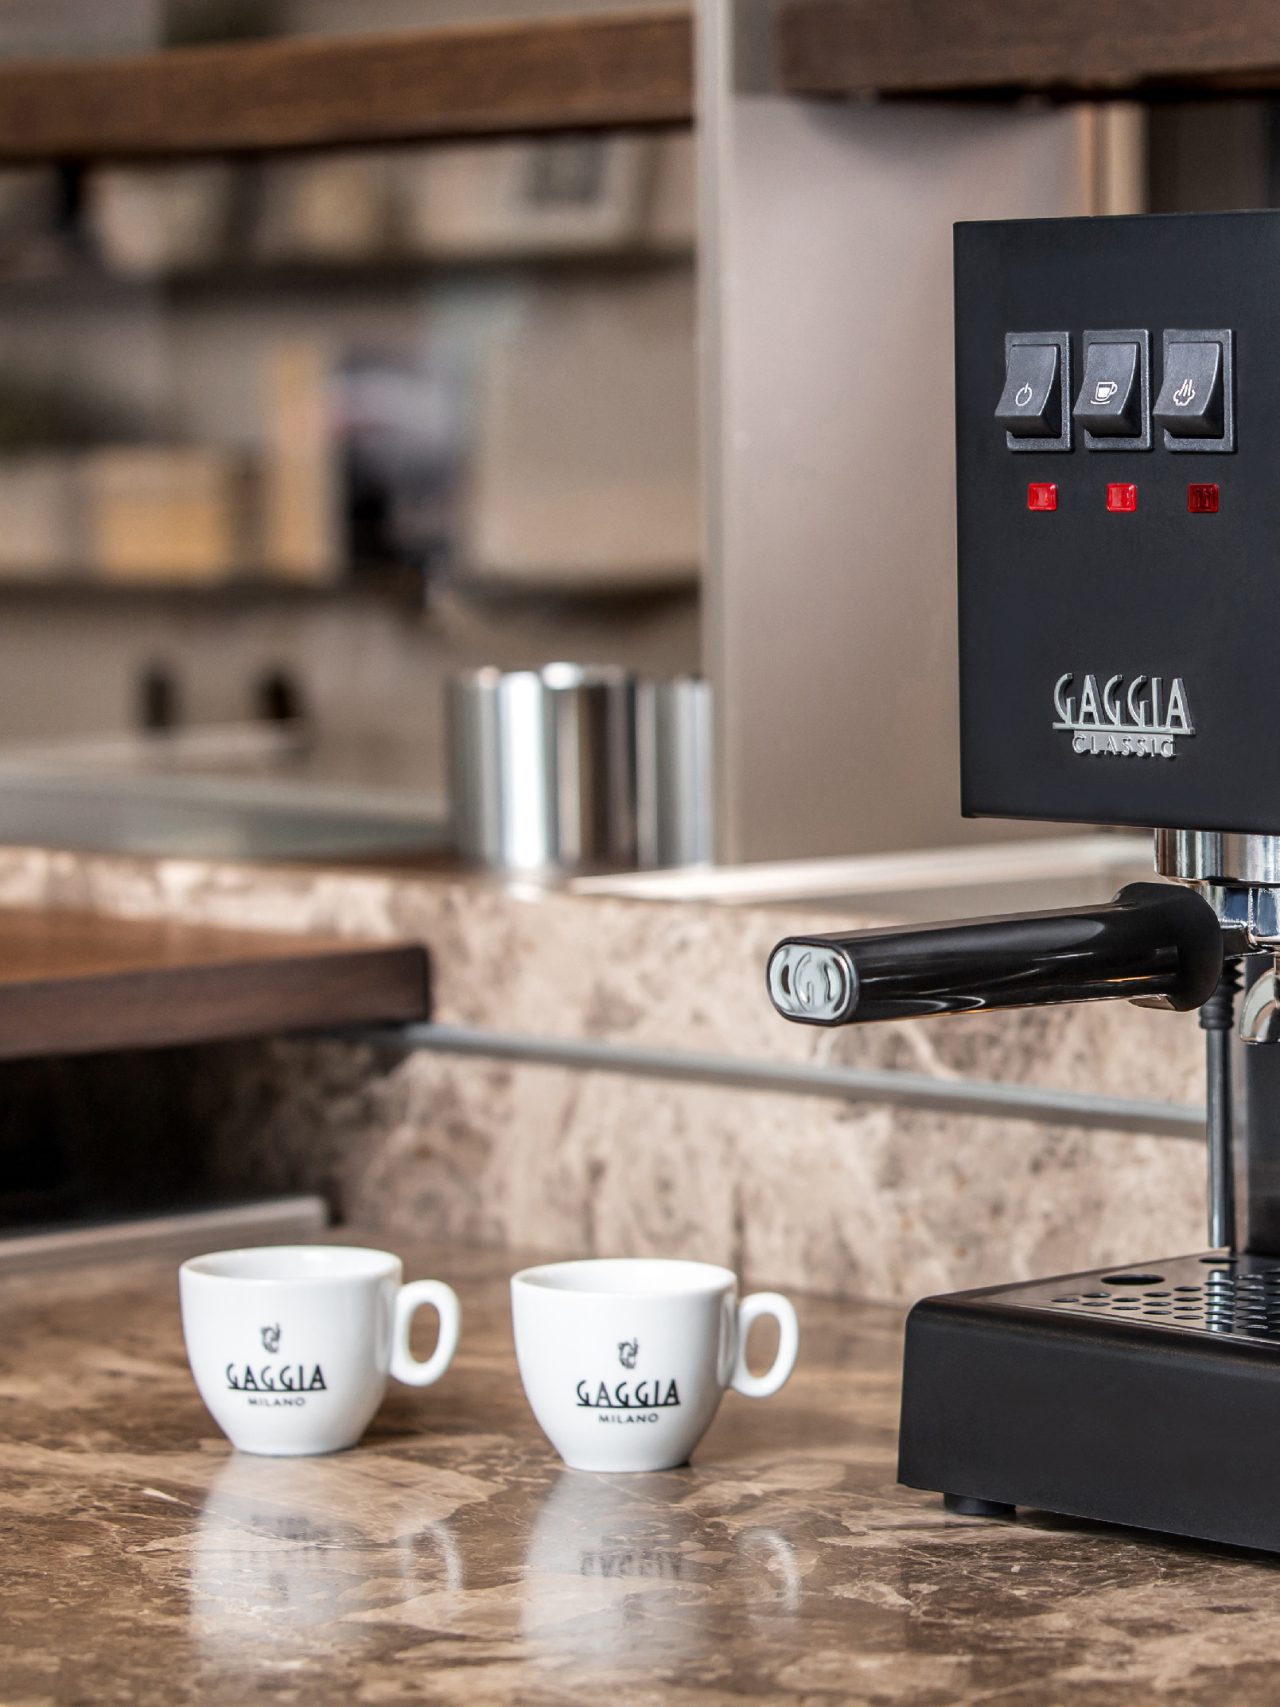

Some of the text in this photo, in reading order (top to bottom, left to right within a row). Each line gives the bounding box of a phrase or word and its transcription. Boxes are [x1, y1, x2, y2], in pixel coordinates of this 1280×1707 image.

[1053, 672, 1195, 733] GAGGIA
[1071, 734, 1176, 758] CLASSIC
[225, 1363, 327, 1392] GAGGIA
[247, 1397, 306, 1407] MILANO
[576, 1378, 681, 1408] GAGGIA
[598, 1413, 659, 1424] MILANO
